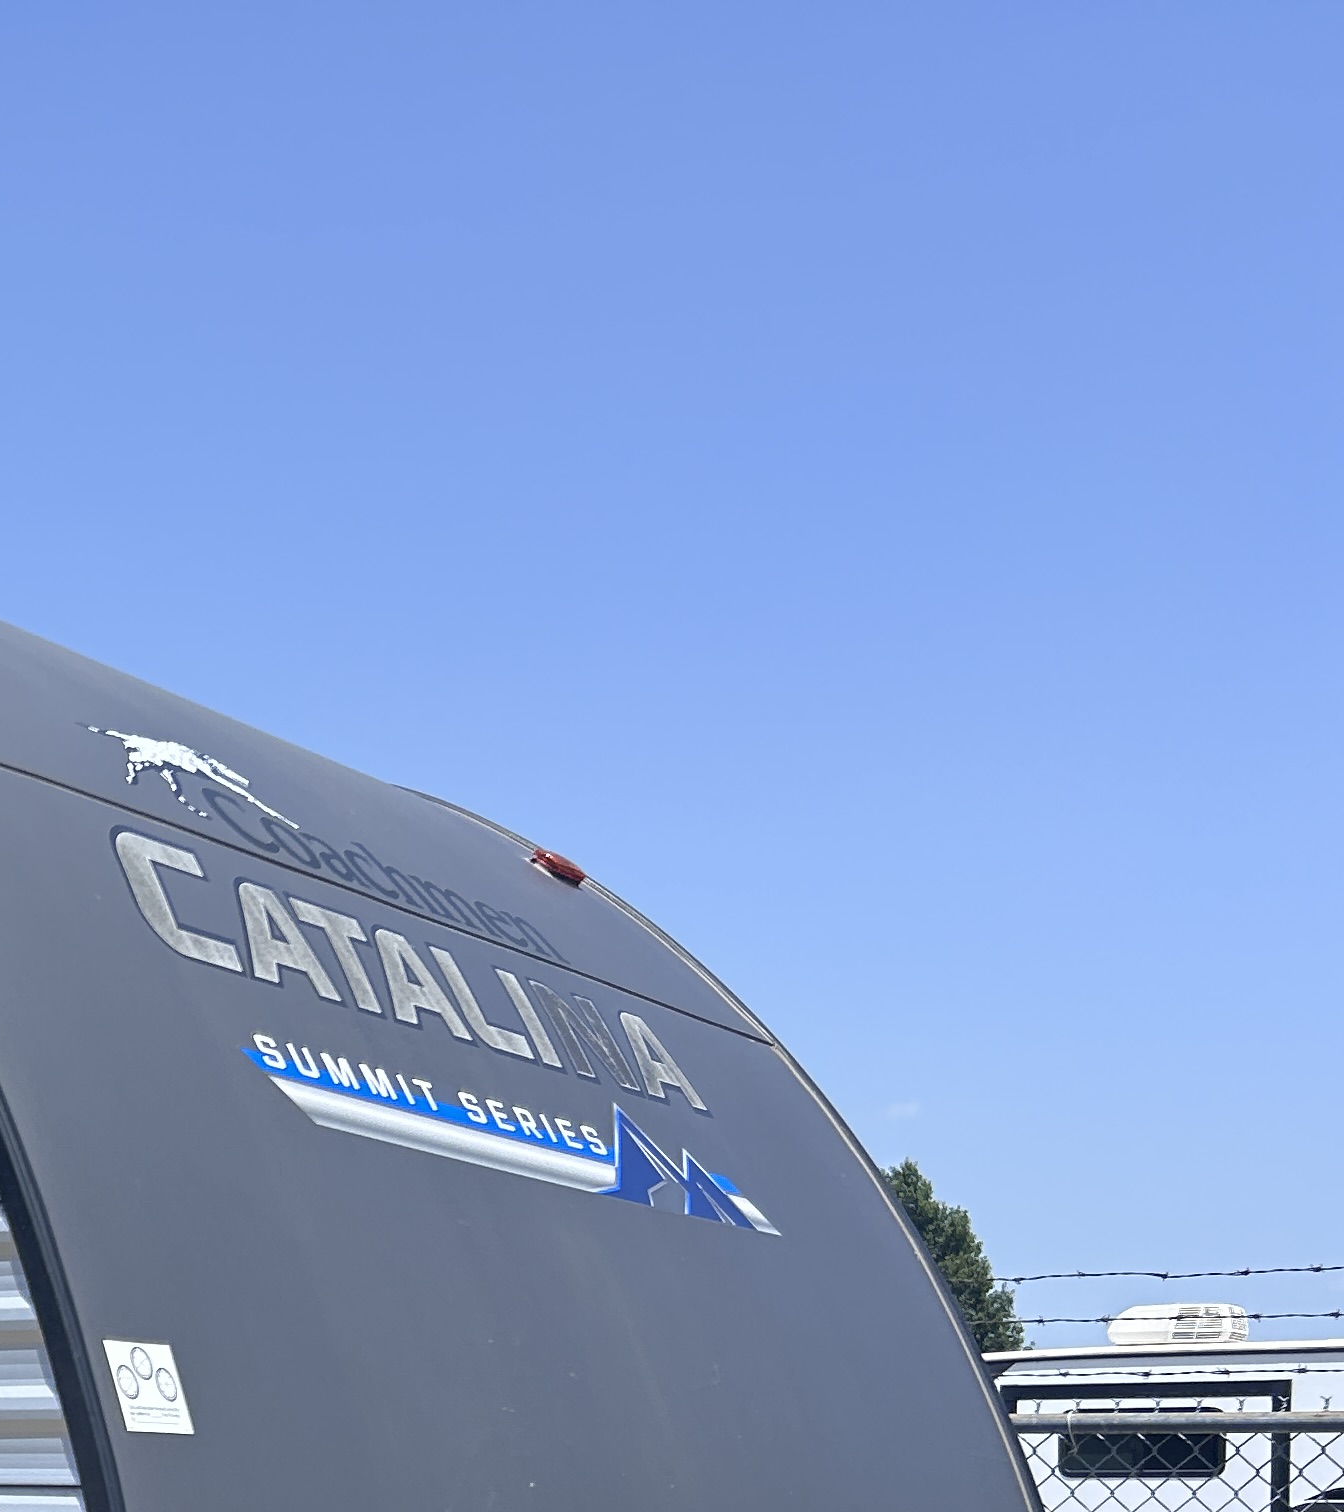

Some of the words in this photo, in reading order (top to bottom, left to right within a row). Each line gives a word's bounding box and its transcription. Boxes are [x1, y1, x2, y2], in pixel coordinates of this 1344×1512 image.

[201, 786, 571, 965] Coachmen
[109, 824, 710, 1113] CATALINA
[251, 1032, 440, 1113] SUMMIT
[457, 1090, 609, 1157] SERIES
